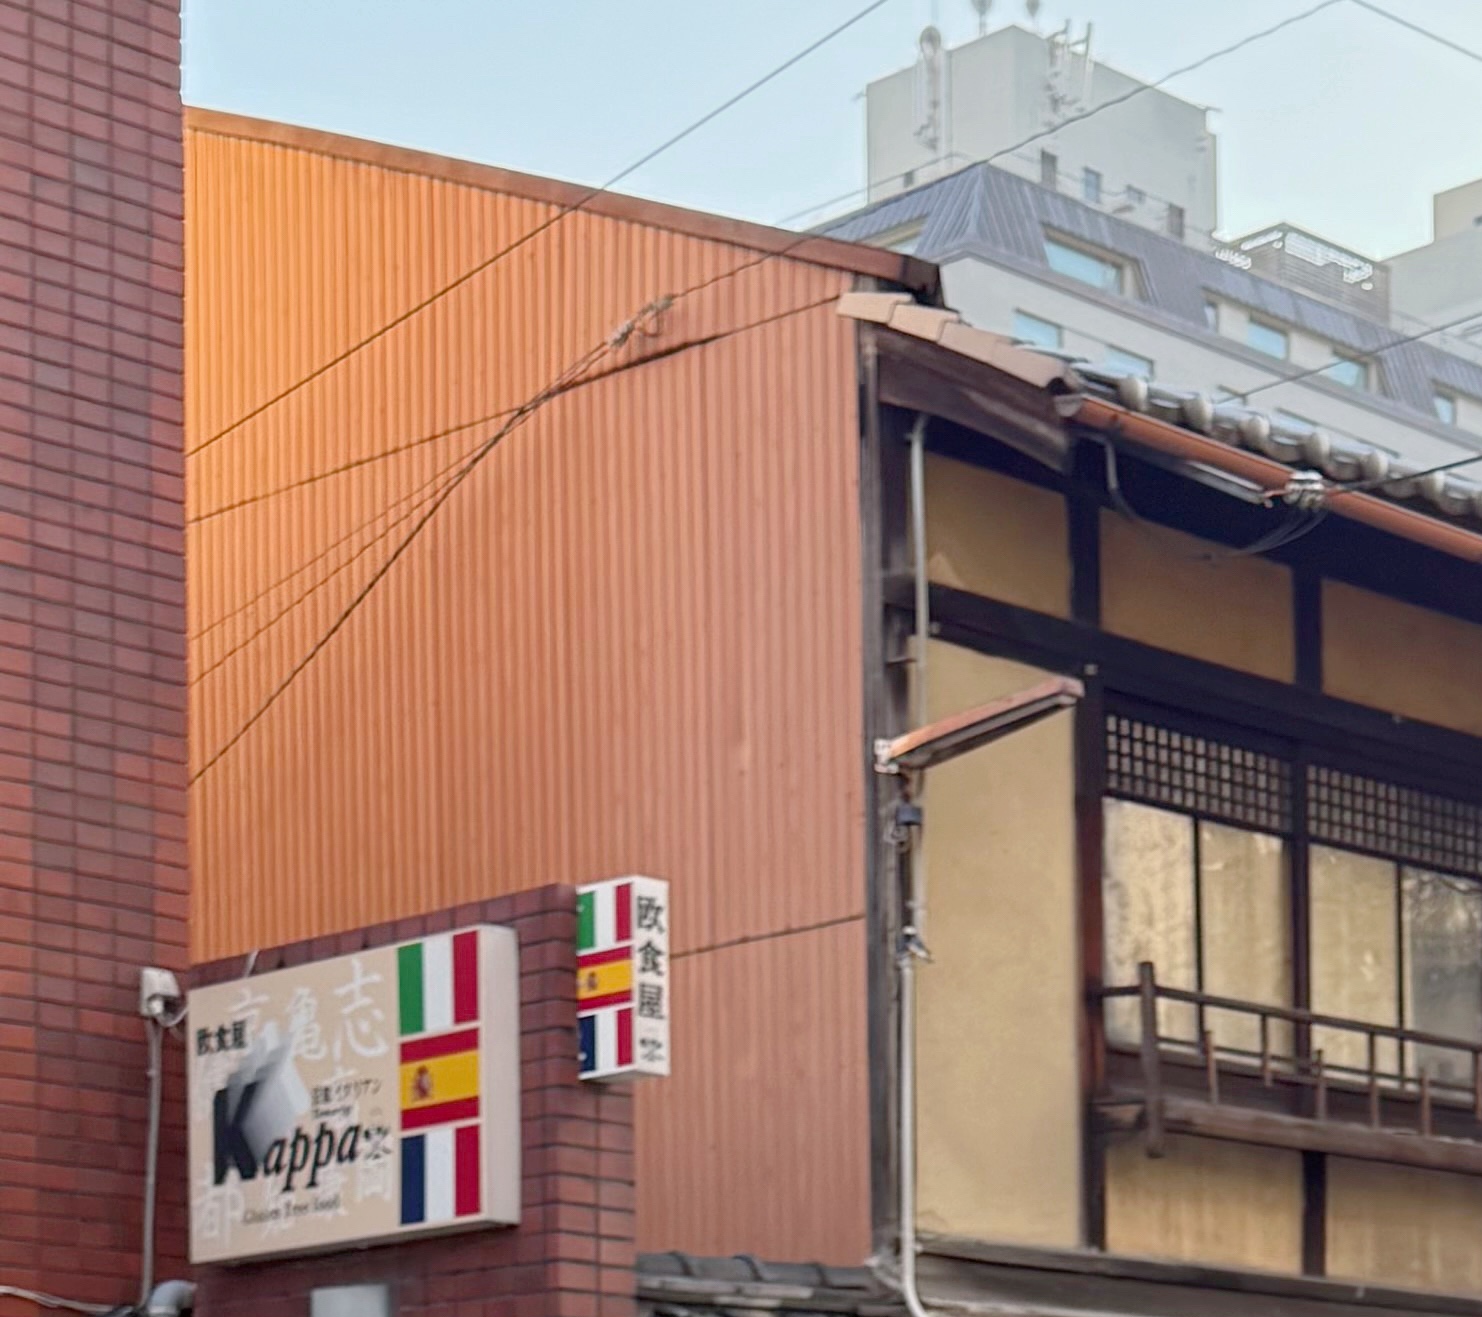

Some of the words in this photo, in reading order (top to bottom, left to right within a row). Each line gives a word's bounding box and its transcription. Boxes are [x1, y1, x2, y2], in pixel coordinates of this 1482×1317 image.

[636, 895, 665, 1020] 欧食屋
[211, 1080, 362, 1193] Kappa
